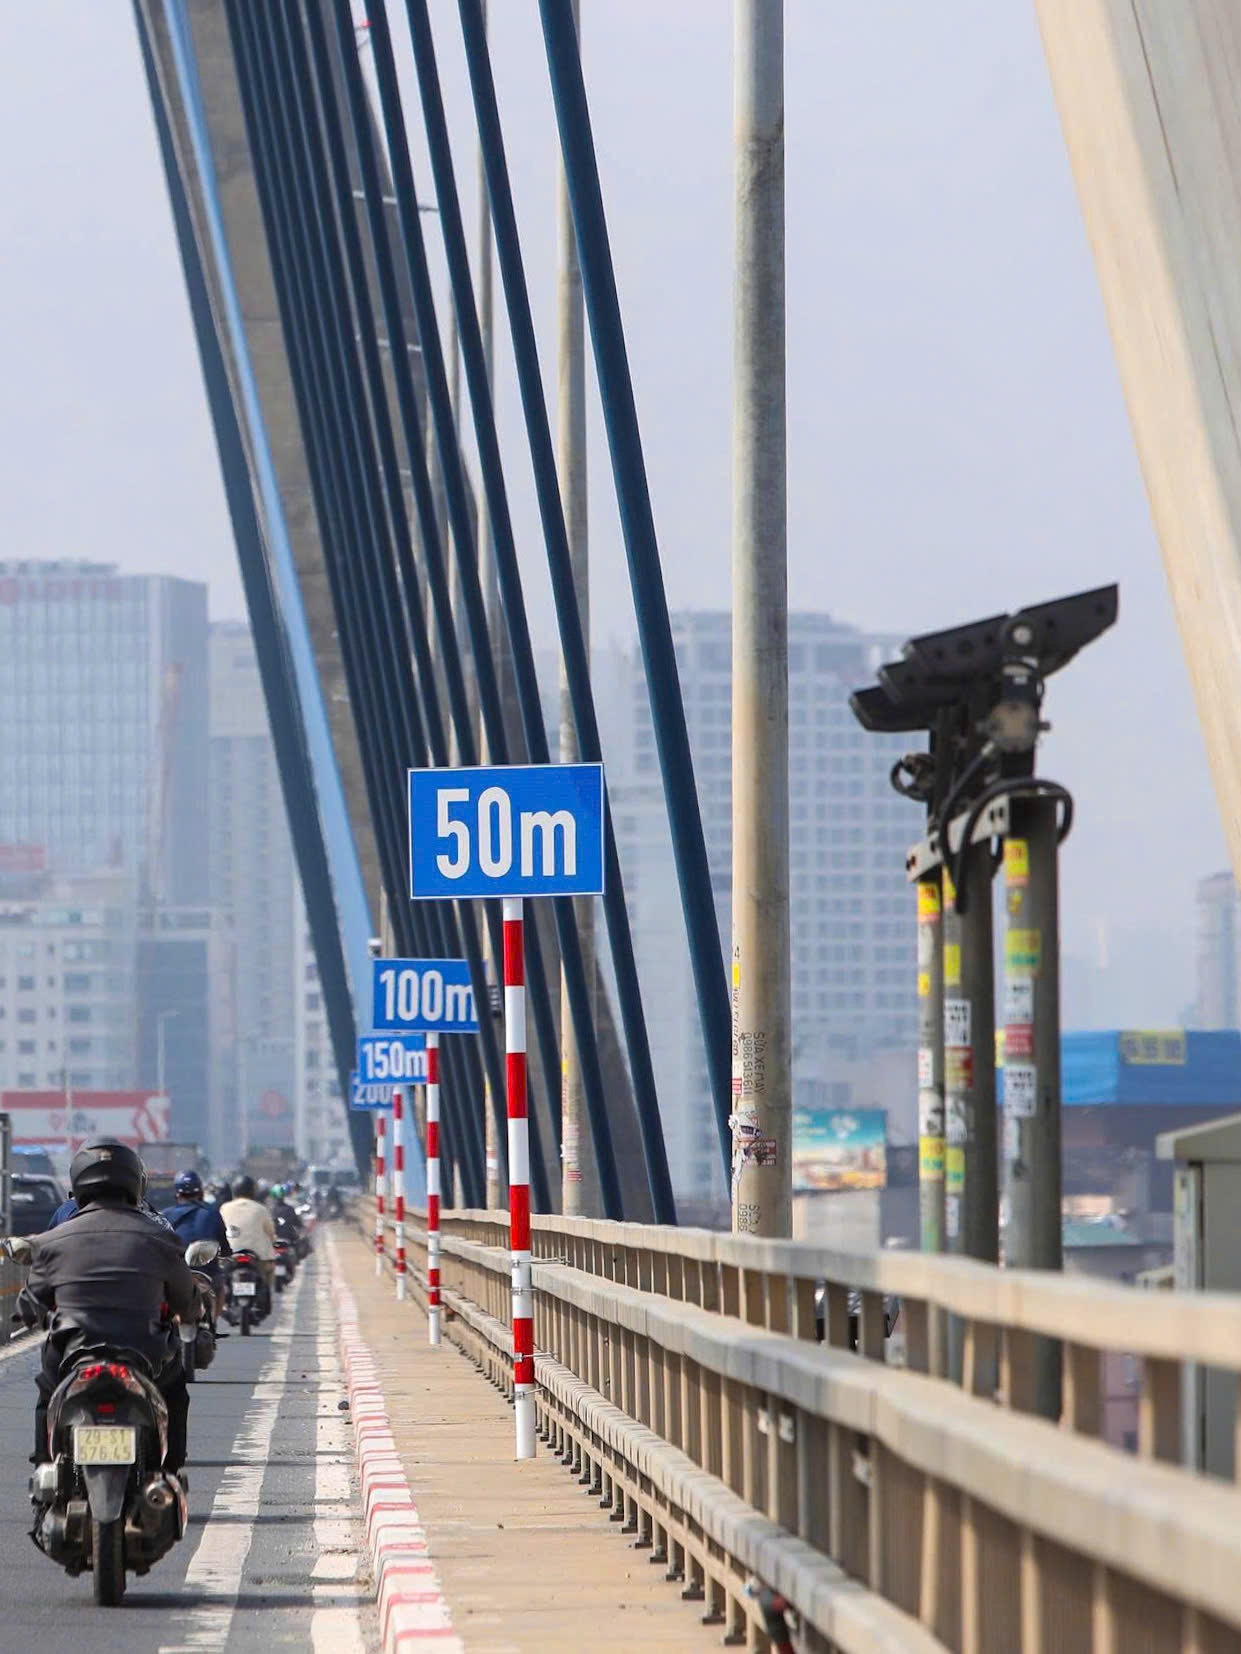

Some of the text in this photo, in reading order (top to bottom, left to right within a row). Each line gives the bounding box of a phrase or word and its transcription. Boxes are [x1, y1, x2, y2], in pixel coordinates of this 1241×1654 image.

[436, 786, 577, 880] 50m
[379, 969, 478, 1023] 100m
[362, 1041, 427, 1080] 150m
[353, 1077, 393, 1105] 200
